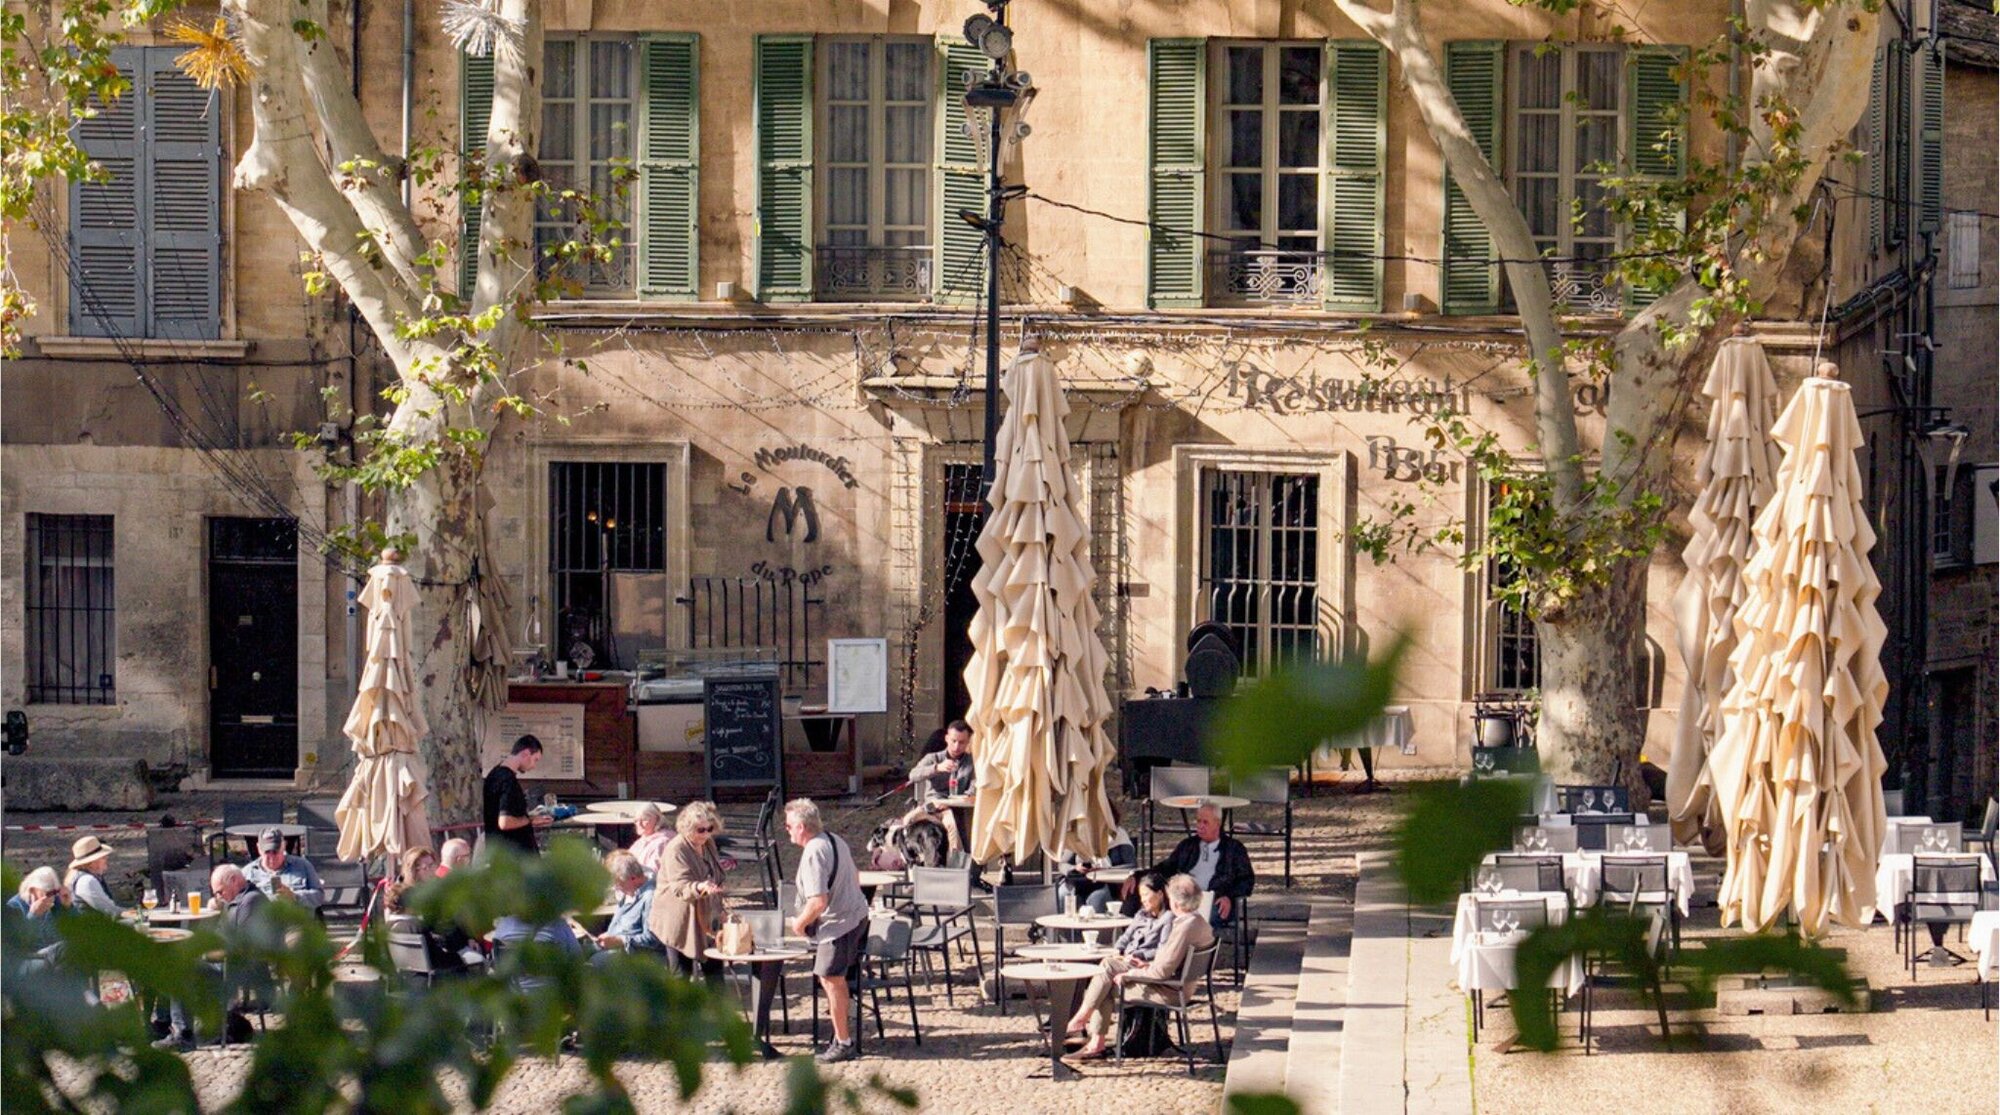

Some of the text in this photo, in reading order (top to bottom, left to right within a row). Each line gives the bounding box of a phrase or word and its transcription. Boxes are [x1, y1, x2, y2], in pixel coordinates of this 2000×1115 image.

[1365, 435, 1447, 470] Bar
[728, 472, 757, 495] Le
[766, 486, 819, 544] M
[751, 560, 774, 580] du
